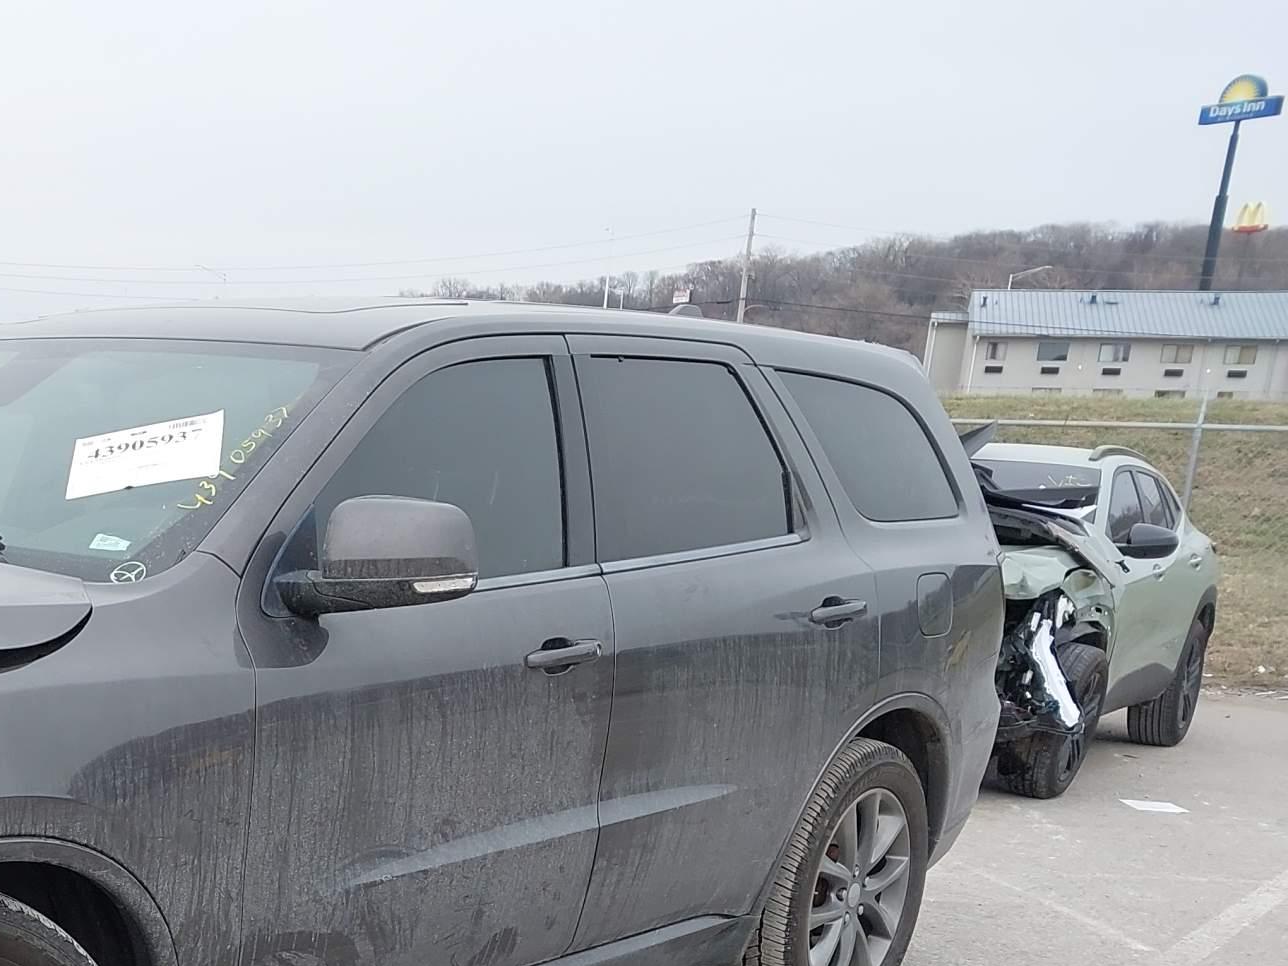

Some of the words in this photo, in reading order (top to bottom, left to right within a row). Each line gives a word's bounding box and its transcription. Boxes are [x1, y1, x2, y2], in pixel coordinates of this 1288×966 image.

[1209, 101, 1240, 118] Days
[1243, 100, 1265, 113] Inn
[87, 428, 203, 459] 43905937
